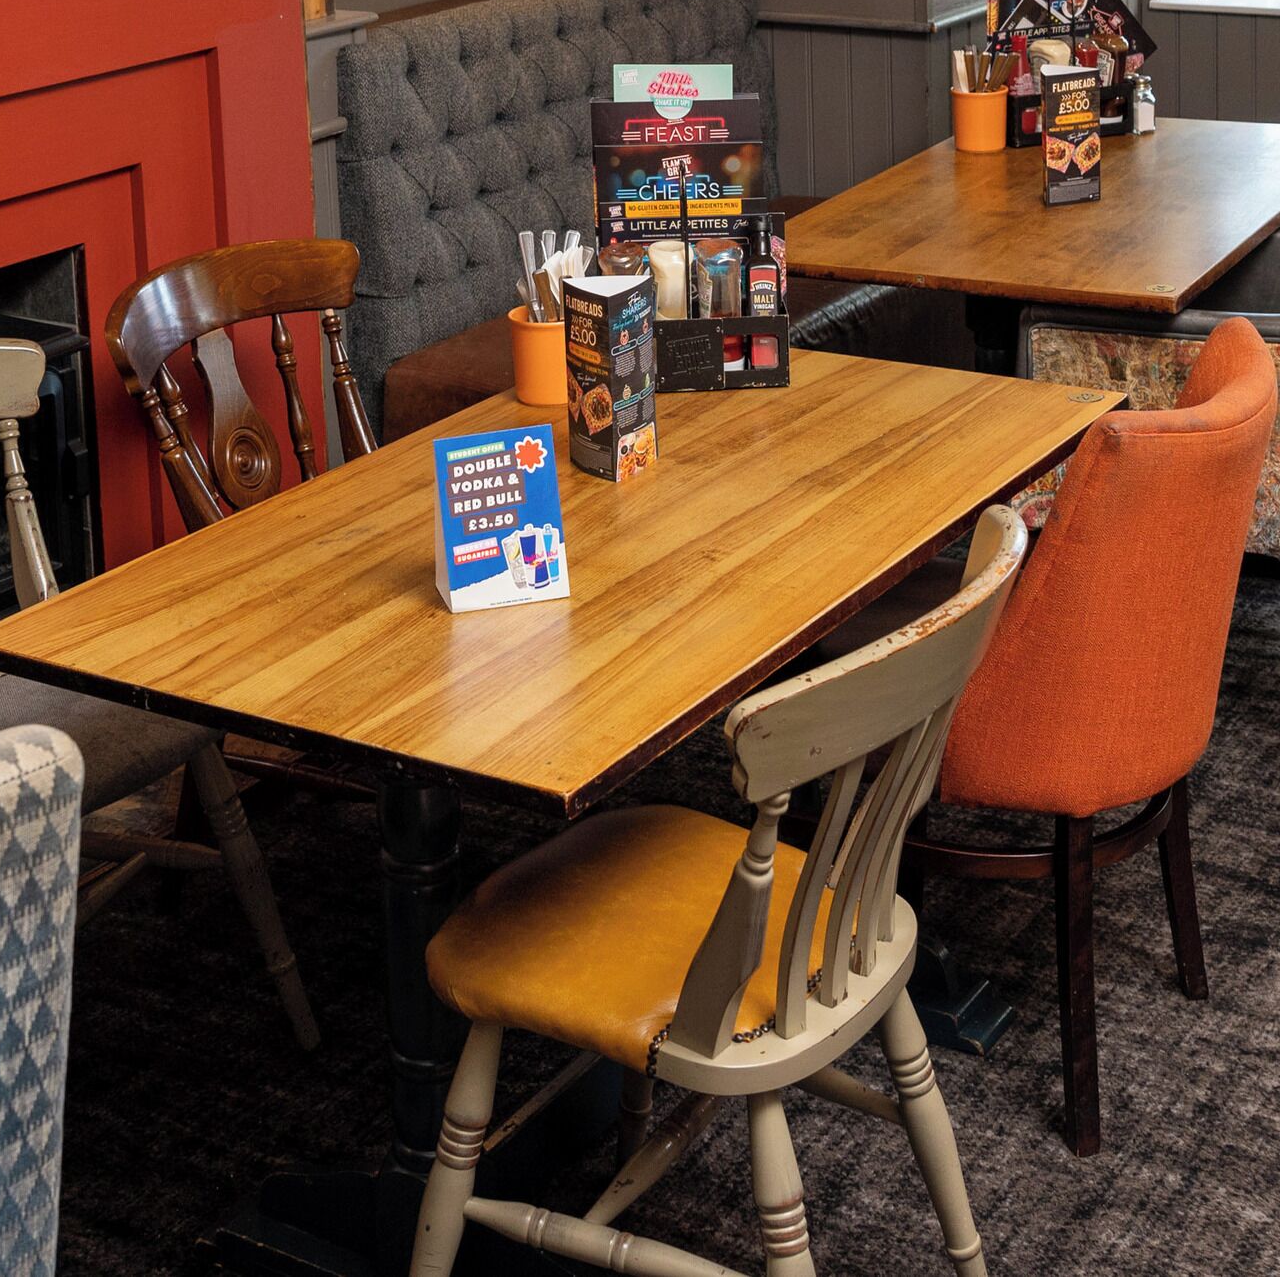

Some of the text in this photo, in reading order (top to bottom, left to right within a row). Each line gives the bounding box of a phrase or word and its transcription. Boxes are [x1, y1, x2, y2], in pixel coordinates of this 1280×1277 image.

[658, 71, 692, 85] Milk
[1052, 77, 1096, 93] FLATBREADS
[647, 82, 699, 97] Shakes
[1071, 90, 1086, 100] FOR
[1059, 98, 1090, 114] £5.00
[645, 126, 706, 142] FEAST
[639, 182, 720, 201] CHEERS
[630, 220, 667, 231] LITTLE
[755, 283, 773, 291] HEINZ
[566, 294, 603, 318] FLATBREADS
[753, 294, 774, 303] MALT
[578, 316, 593, 329] FOR
[570, 325, 597, 346] £5.00
[448, 442, 504, 460] STUDENT OFFER
[453, 454, 512, 478] DOUBLE
[451, 472, 520, 495] VODKA &
[453, 490, 522, 515] RED BULL
[468, 513, 515, 532] £3.50
[457, 549, 498, 563] SUGARFREE
